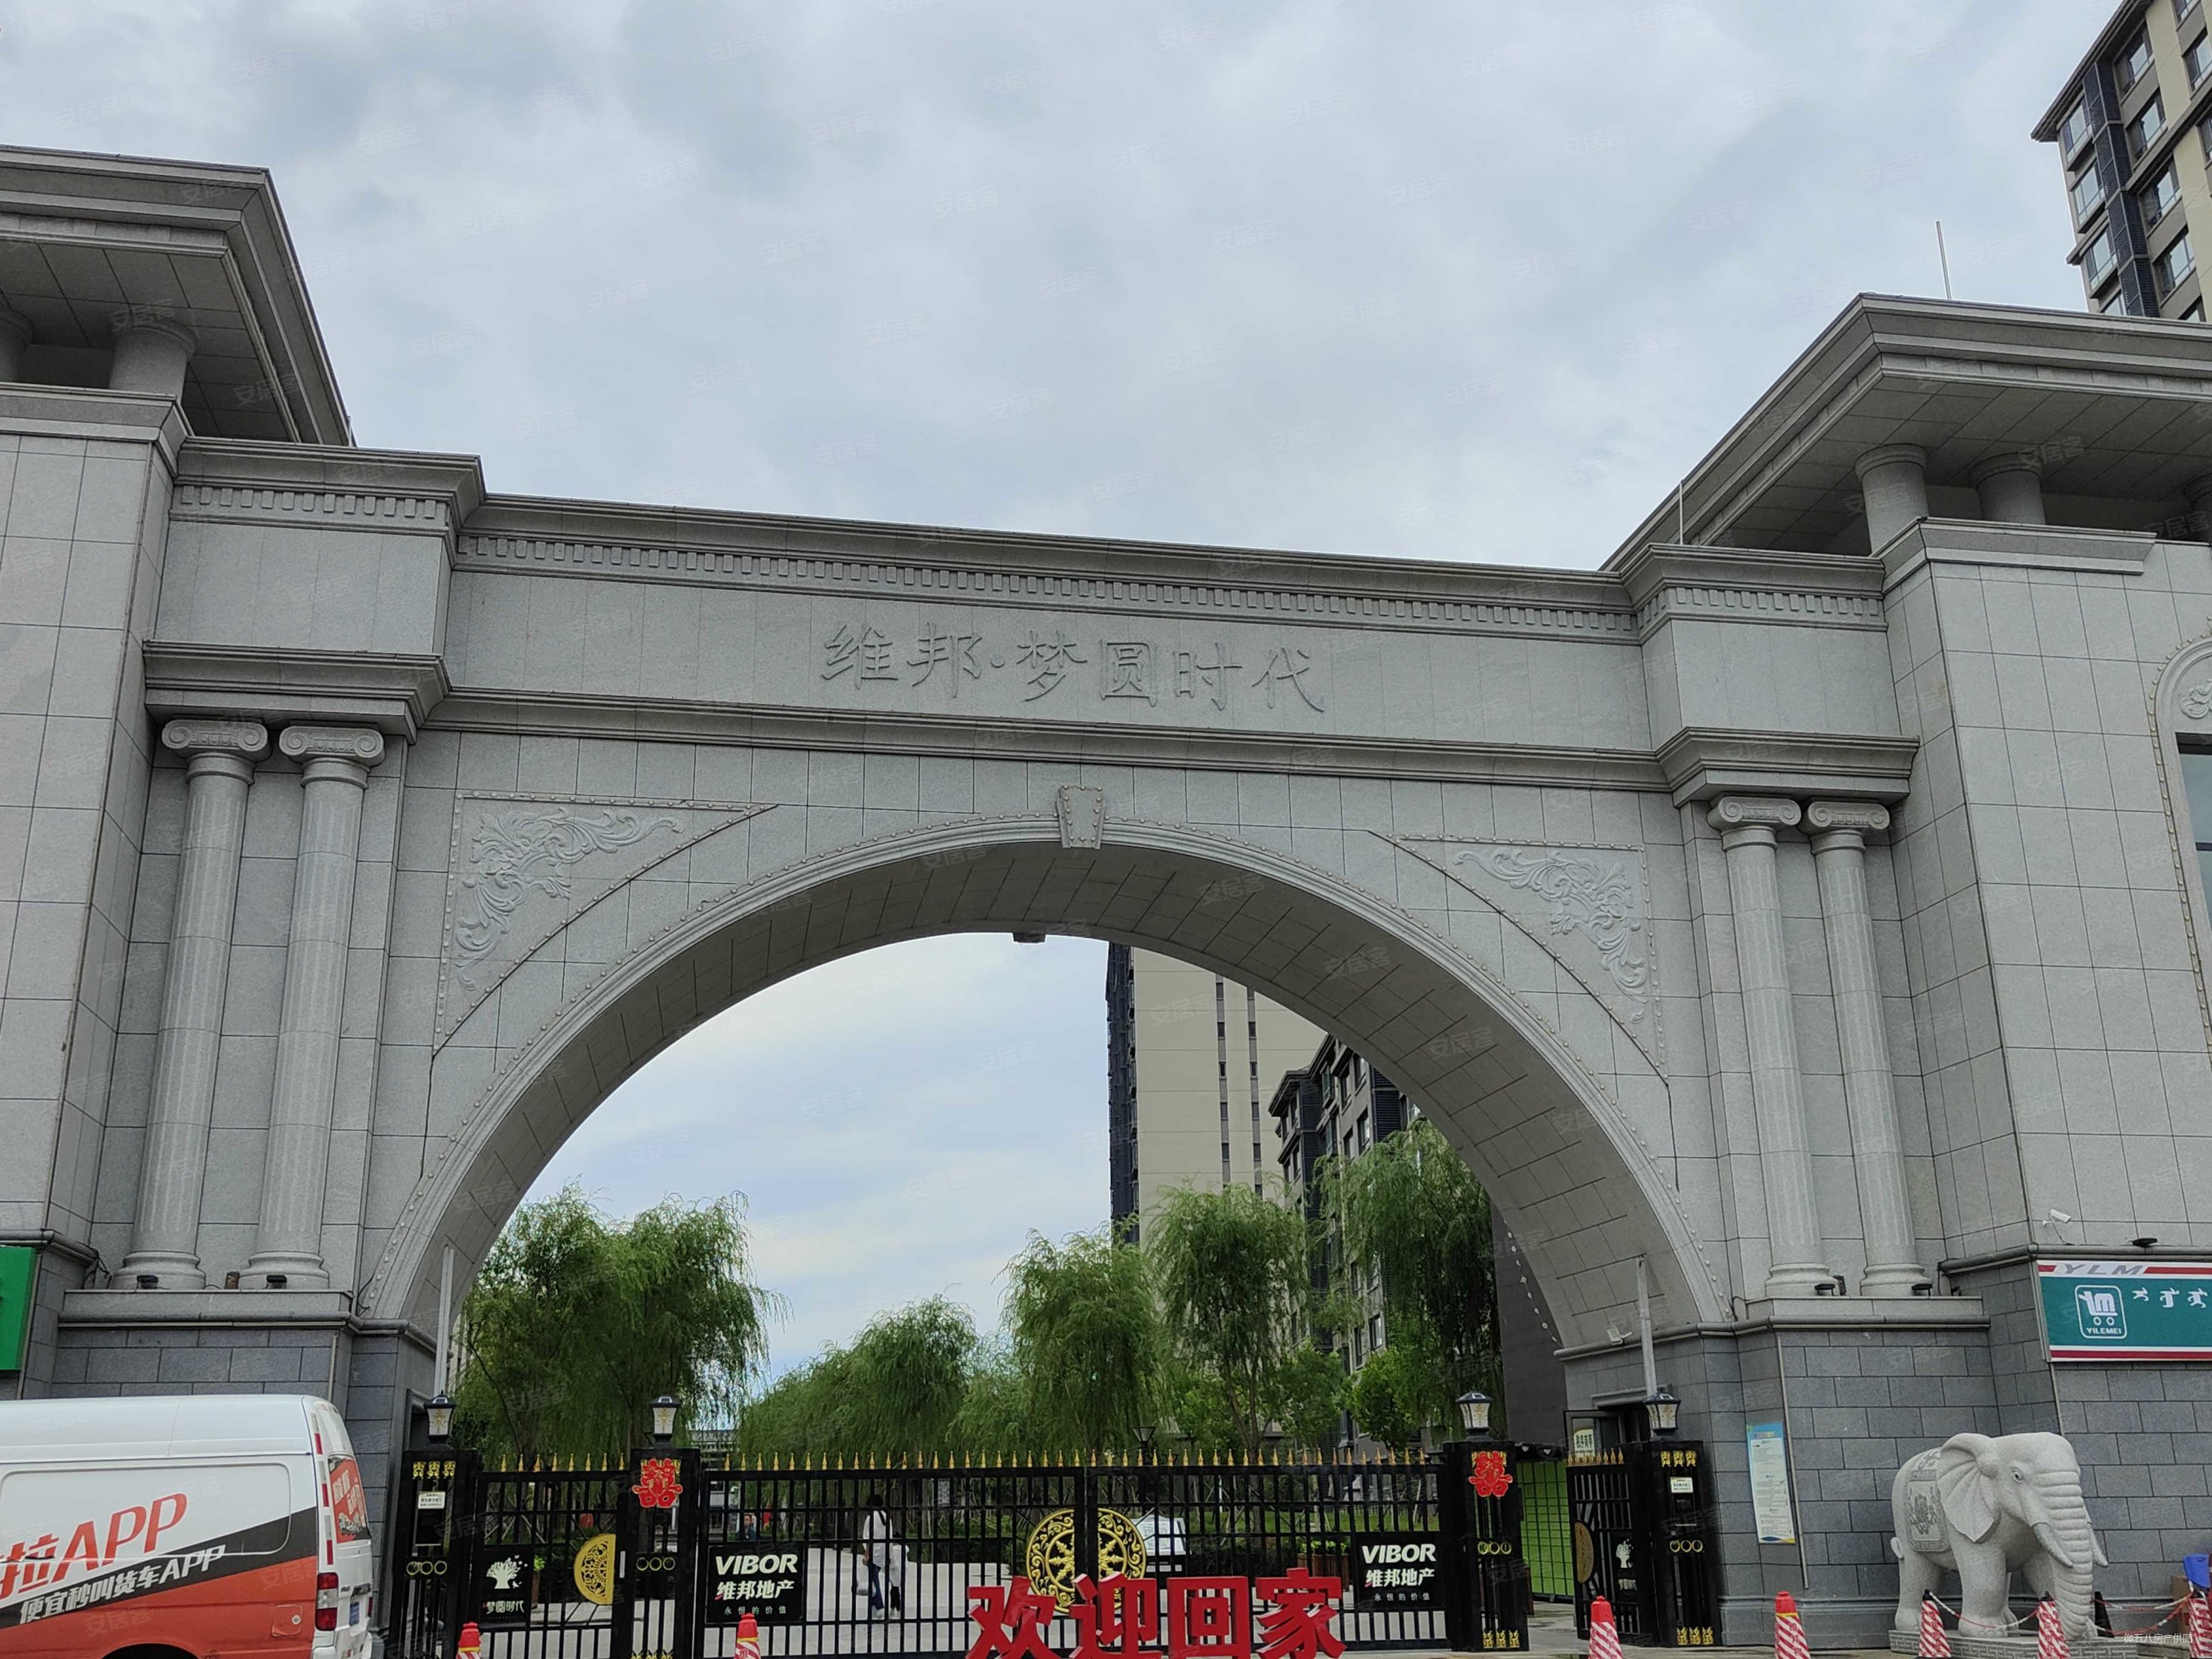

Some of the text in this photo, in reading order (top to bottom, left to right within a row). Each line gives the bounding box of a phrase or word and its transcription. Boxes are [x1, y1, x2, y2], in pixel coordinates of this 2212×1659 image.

[821, 622, 1325, 713] 维邦·梦圆时代
[2064, 1264, 2143, 1276] YLM
[0, 1492, 188, 1599] 拉APP
[1361, 1543, 1437, 1564] VIBOR
[715, 1553, 798, 1575] VIBOR
[19, 1544, 226, 1625] 便宜秒叫货车APP
[1364, 1568, 1435, 1588] 维邦地产
[714, 1579, 795, 1601] 维邦地产
[1374, 1592, 1430, 1602] 永恒的价值
[486, 1599, 525, 1615] 梦圆时代
[965, 1567, 1347, 1659] 欢迎回家
